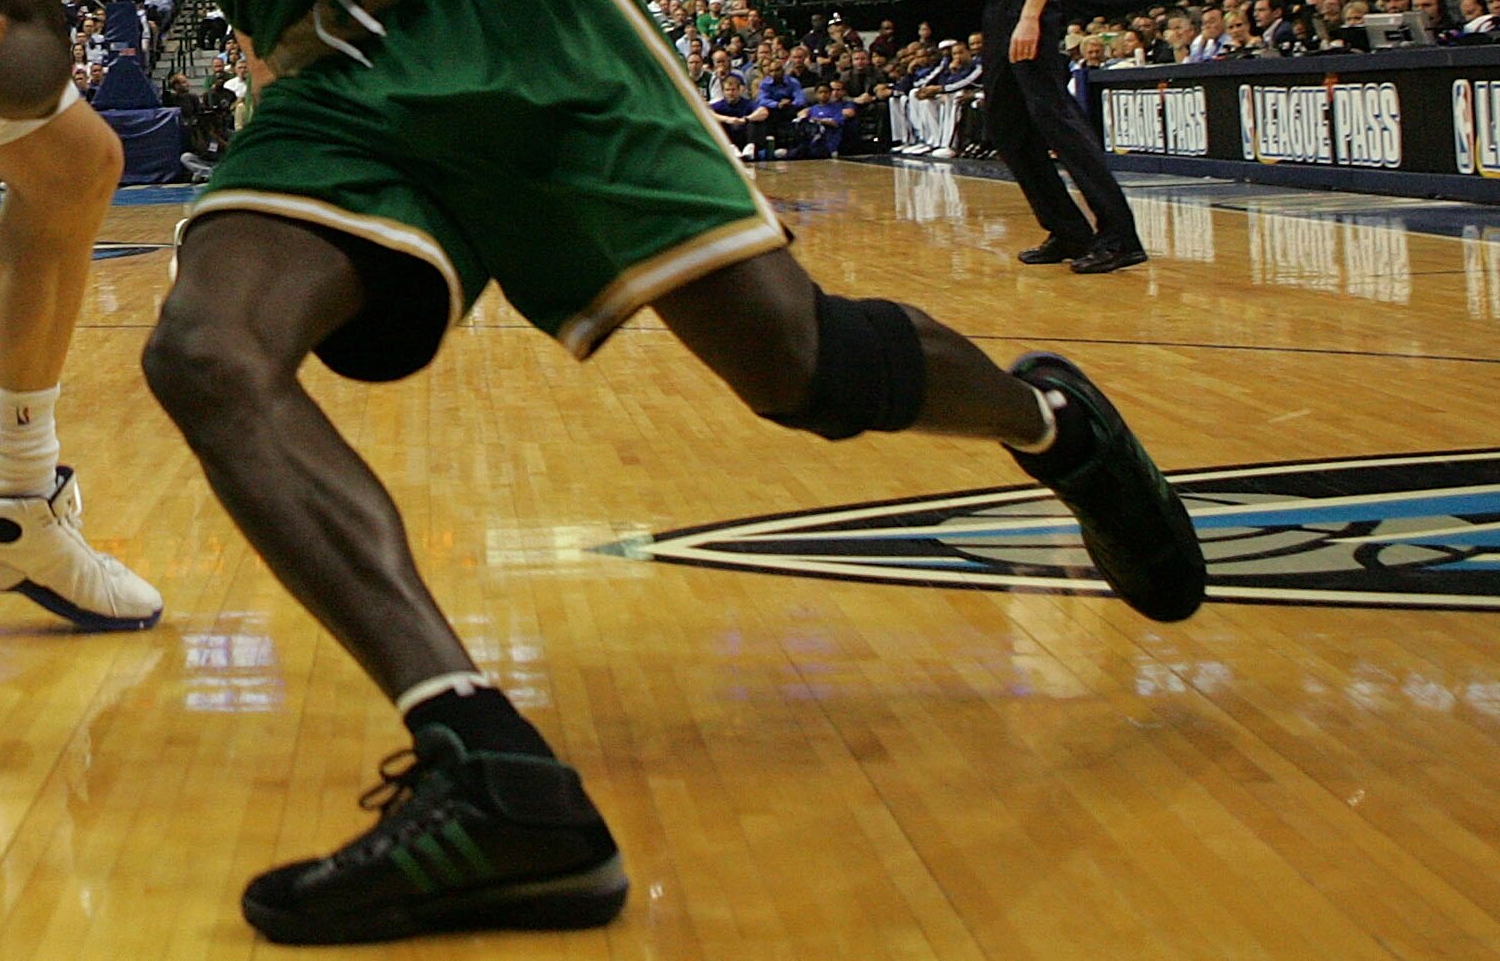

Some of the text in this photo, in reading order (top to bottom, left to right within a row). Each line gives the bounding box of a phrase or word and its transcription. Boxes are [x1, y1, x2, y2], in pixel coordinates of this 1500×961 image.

[1112, 86, 1209, 156] LEAGUE PASS
[1253, 82, 1401, 168] LEAGUE PASS
